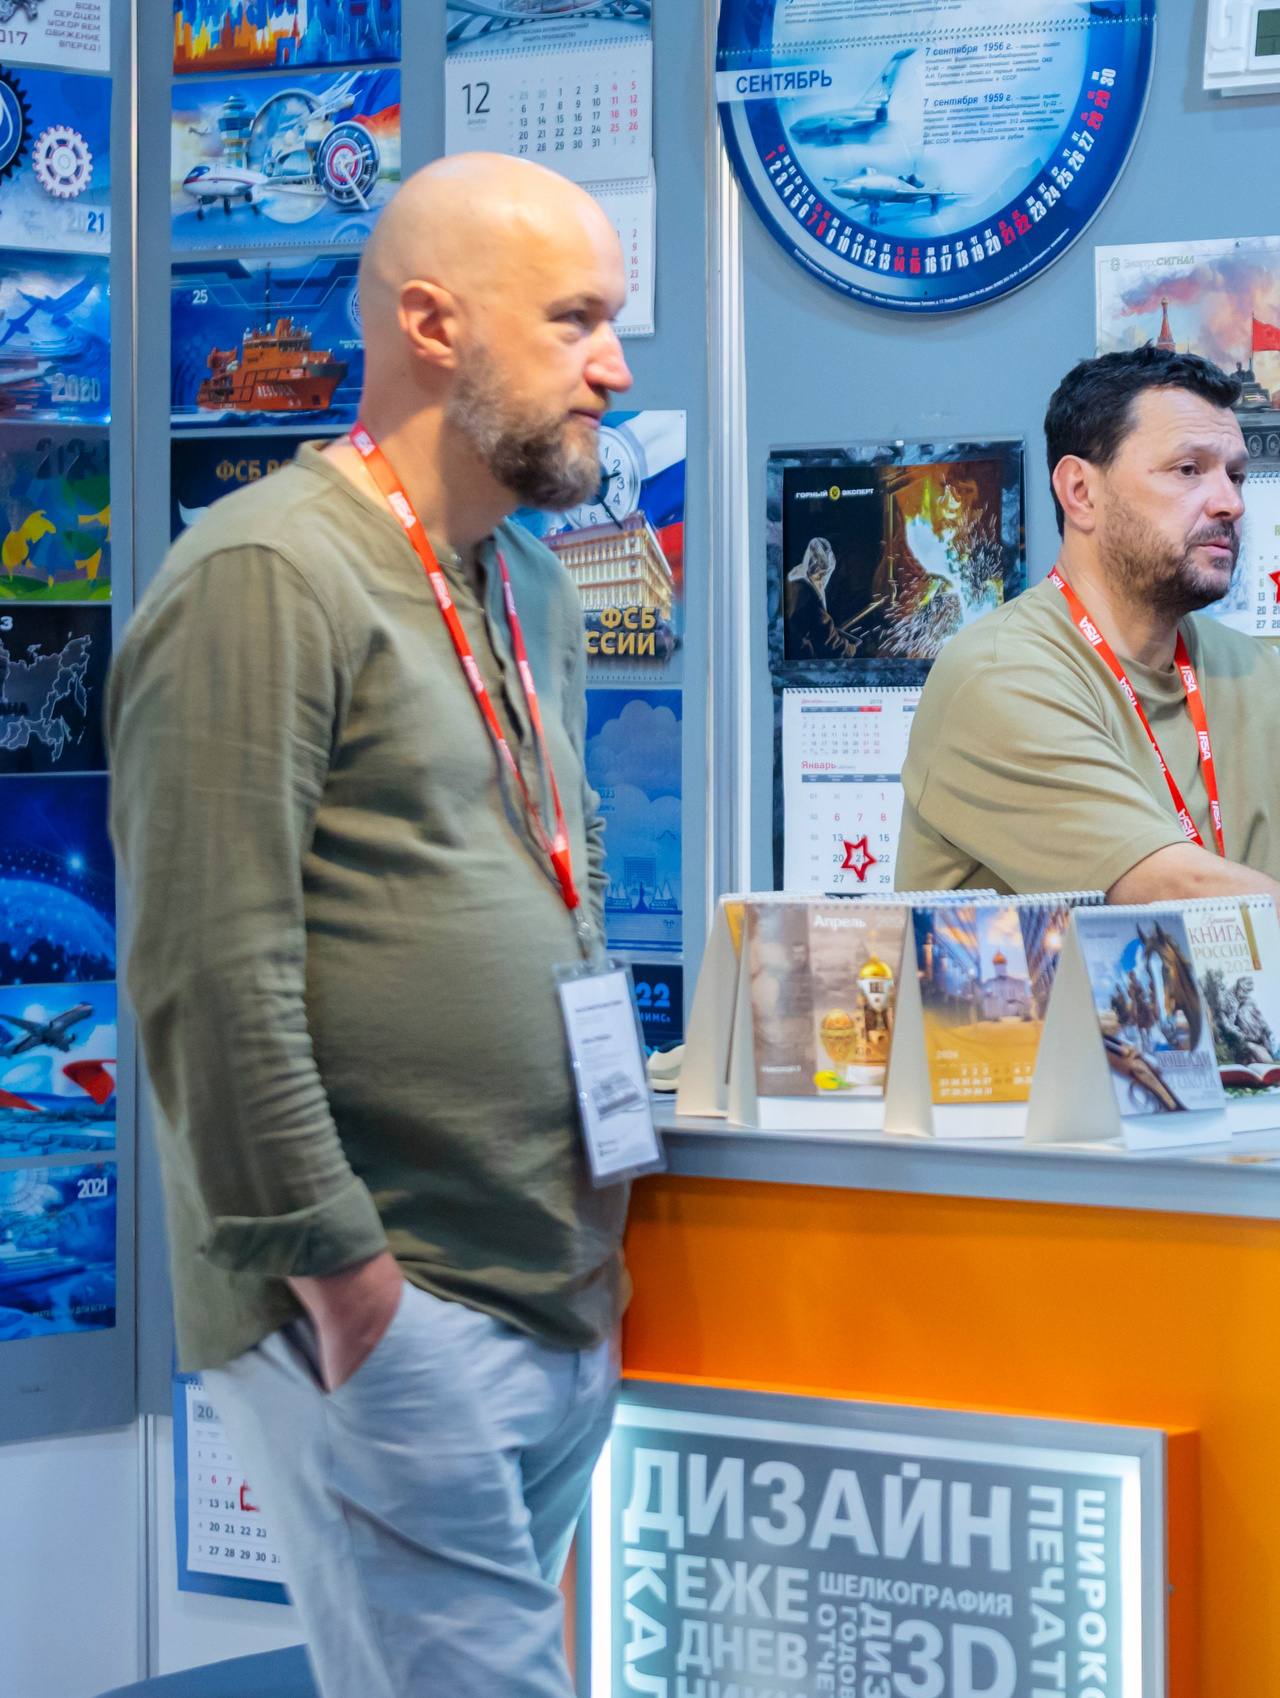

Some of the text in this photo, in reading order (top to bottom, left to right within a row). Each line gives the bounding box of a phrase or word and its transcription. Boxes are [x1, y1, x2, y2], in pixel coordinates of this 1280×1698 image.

[926, 48, 931, 56] 7
[933, 45, 978, 56] сентября
[984, 42, 1003, 52] 1956
[736, 69, 833, 94] СЕНТЯБРЬ
[462, 81, 491, 114] 12
[522, 105, 526, 113] 6
[541, 103, 544, 111] 7
[558, 101, 563, 109] 8
[576, 100, 580, 108] 9
[593, 98, 600, 106] 10
[630, 95, 637, 103] 12
[924, 99, 929, 107] 7
[934, 96, 978, 107] сентября
[984, 93, 1003, 103] 1959
[520, 118, 527, 126] 13
[557, 115, 564, 123] 15
[574, 113, 582, 121] 16
[593, 112, 600, 120] 17
[611, 110, 619, 118] 18
[630, 109, 637, 117] 19
[925, 130, 1095, 273] 16 17 18 19 20 23 24 25 26 27
[216, 459, 262, 482] ФСБ
[841, 488, 875, 496] ЭКСПЕРТ
[601, 607, 656, 629] ФСБ
[802, 761, 837, 770] Январь
[813, 914, 866, 928] Апрель
[1188, 926, 1246, 944] КНИГА
[1193, 943, 1251, 959] РОССИИ
[78, 1178, 108, 1199] 2021
[622, 1447, 1011, 1571] ДИЗАЙН
[676, 1553, 809, 1623] ЕЖЕ
[819, 1571, 1013, 1617] ШЕЛКОГРАФИЯ
[676, 1618, 809, 1680] ДНЕВ
[817, 1603, 838, 1698] ОТЧЕ
[892, 1618, 1017, 1698] 3D
